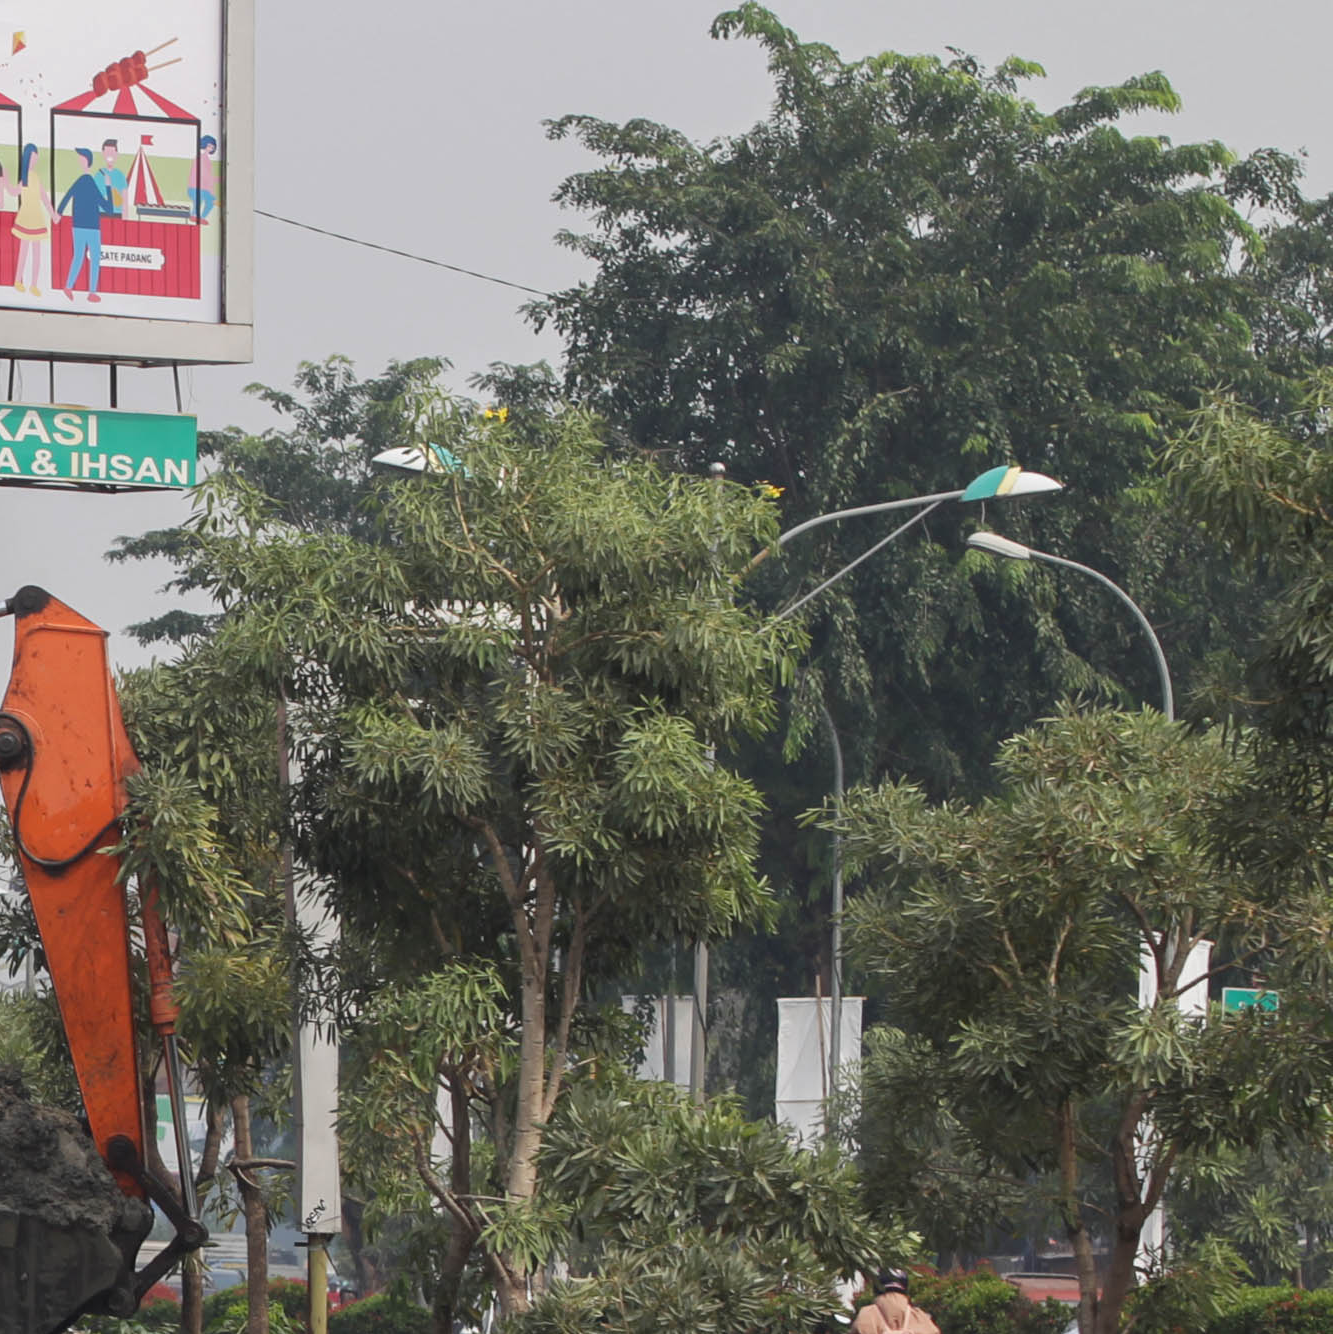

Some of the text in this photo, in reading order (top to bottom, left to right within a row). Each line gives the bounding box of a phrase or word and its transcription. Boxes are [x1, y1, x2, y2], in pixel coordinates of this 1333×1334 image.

[100, 252, 152, 264] SATE PADANG
[31, 449, 58, 478] &
[70, 451, 189, 485] IHSAN
